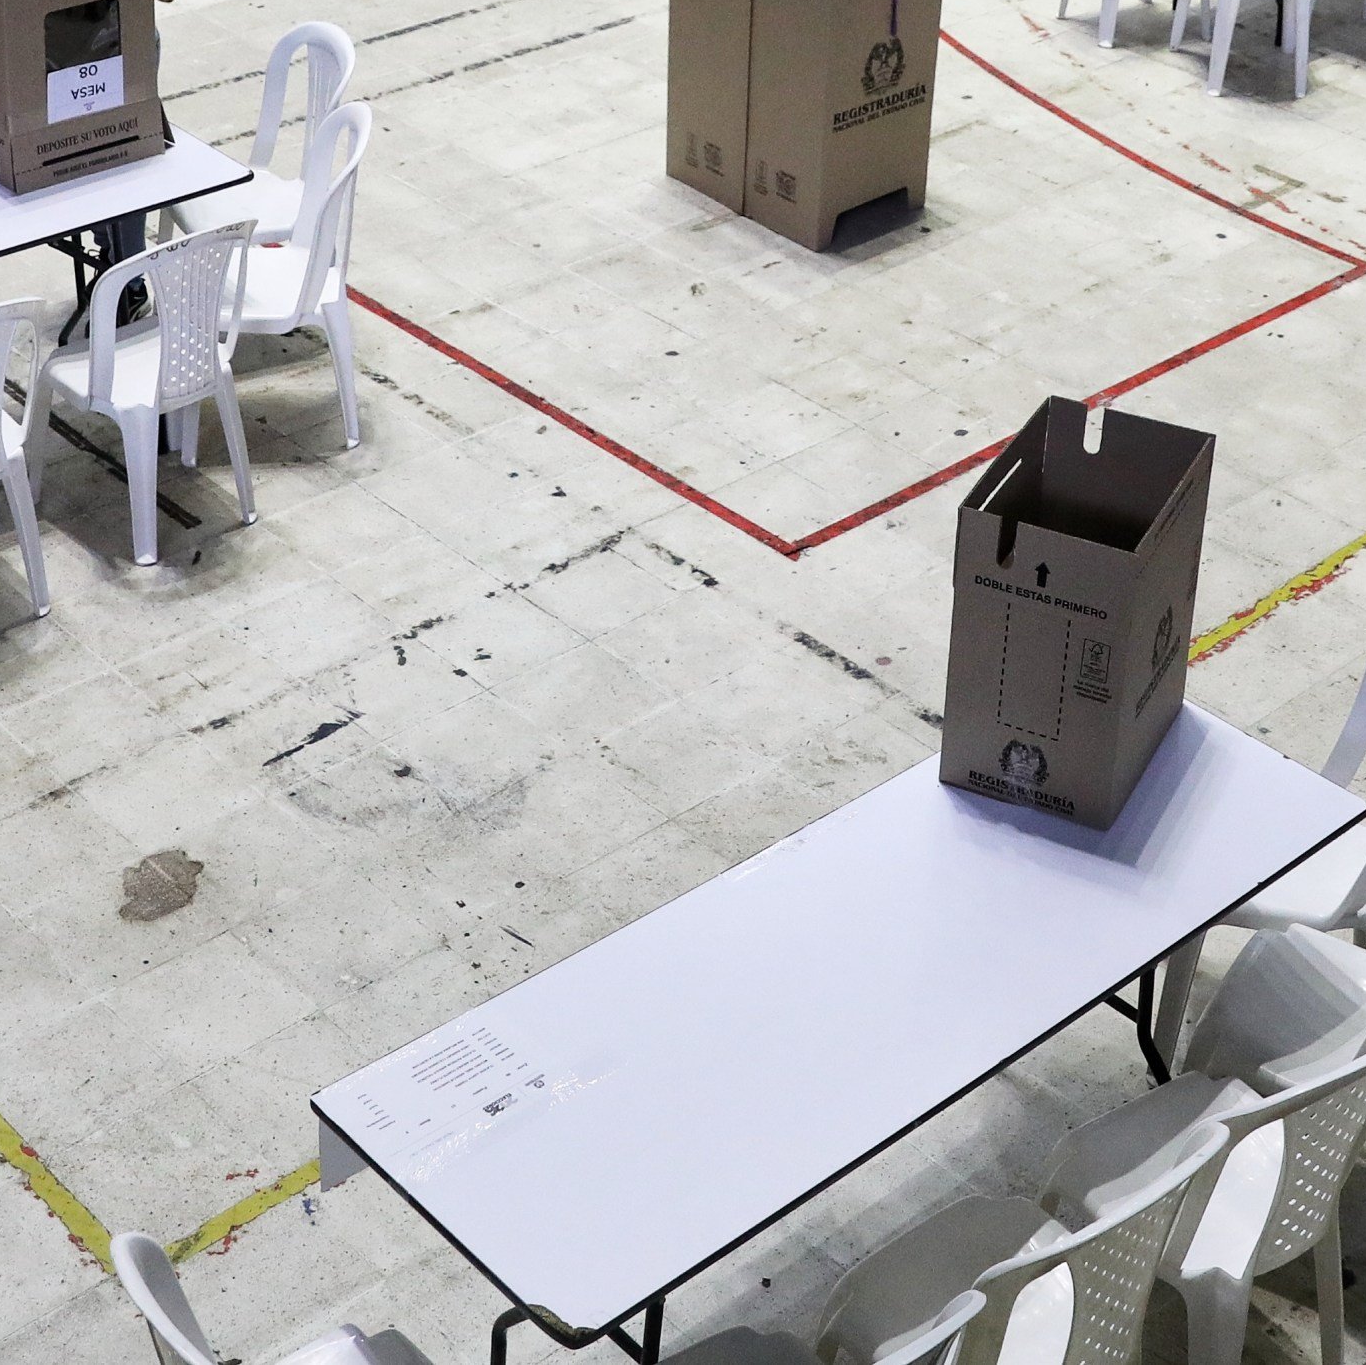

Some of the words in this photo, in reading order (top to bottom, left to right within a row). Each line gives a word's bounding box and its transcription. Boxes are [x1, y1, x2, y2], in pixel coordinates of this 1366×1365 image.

[70, 82, 106, 100] MESA
[833, 81, 926, 126] REGISTRADURÍA
[36, 136, 79, 155] DEPOSITE
[80, 131, 93, 144] SU
[93, 124, 116, 139] VOTO
[974, 574, 1013, 595] DOBLE
[1015, 585, 1052, 605] ESTAS
[1054, 598, 1108, 621] PRIMERO
